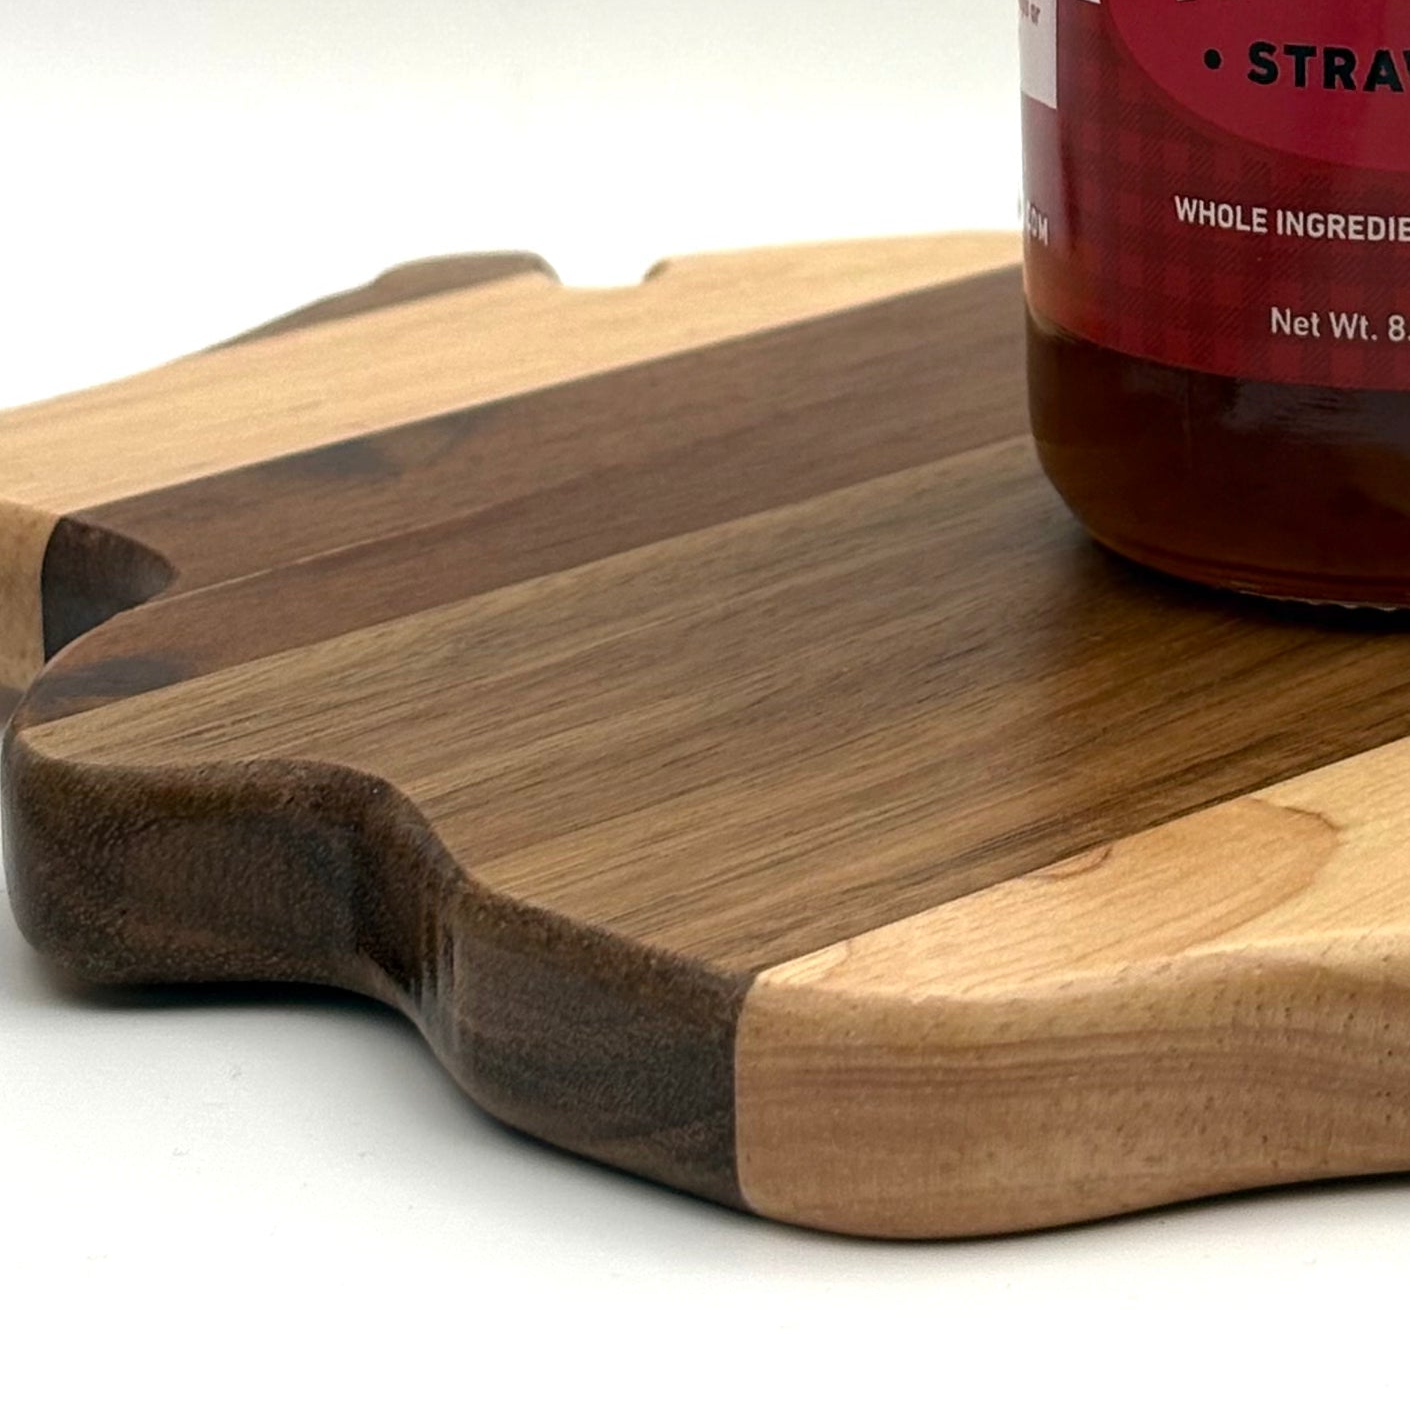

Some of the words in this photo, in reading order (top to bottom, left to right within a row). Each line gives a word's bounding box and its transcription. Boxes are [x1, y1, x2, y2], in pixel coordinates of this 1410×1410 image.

[1174, 194, 1269, 235] WHOLE
[1270, 306, 1321, 339] Net
[1329, 311, 1379, 342] Wt.
